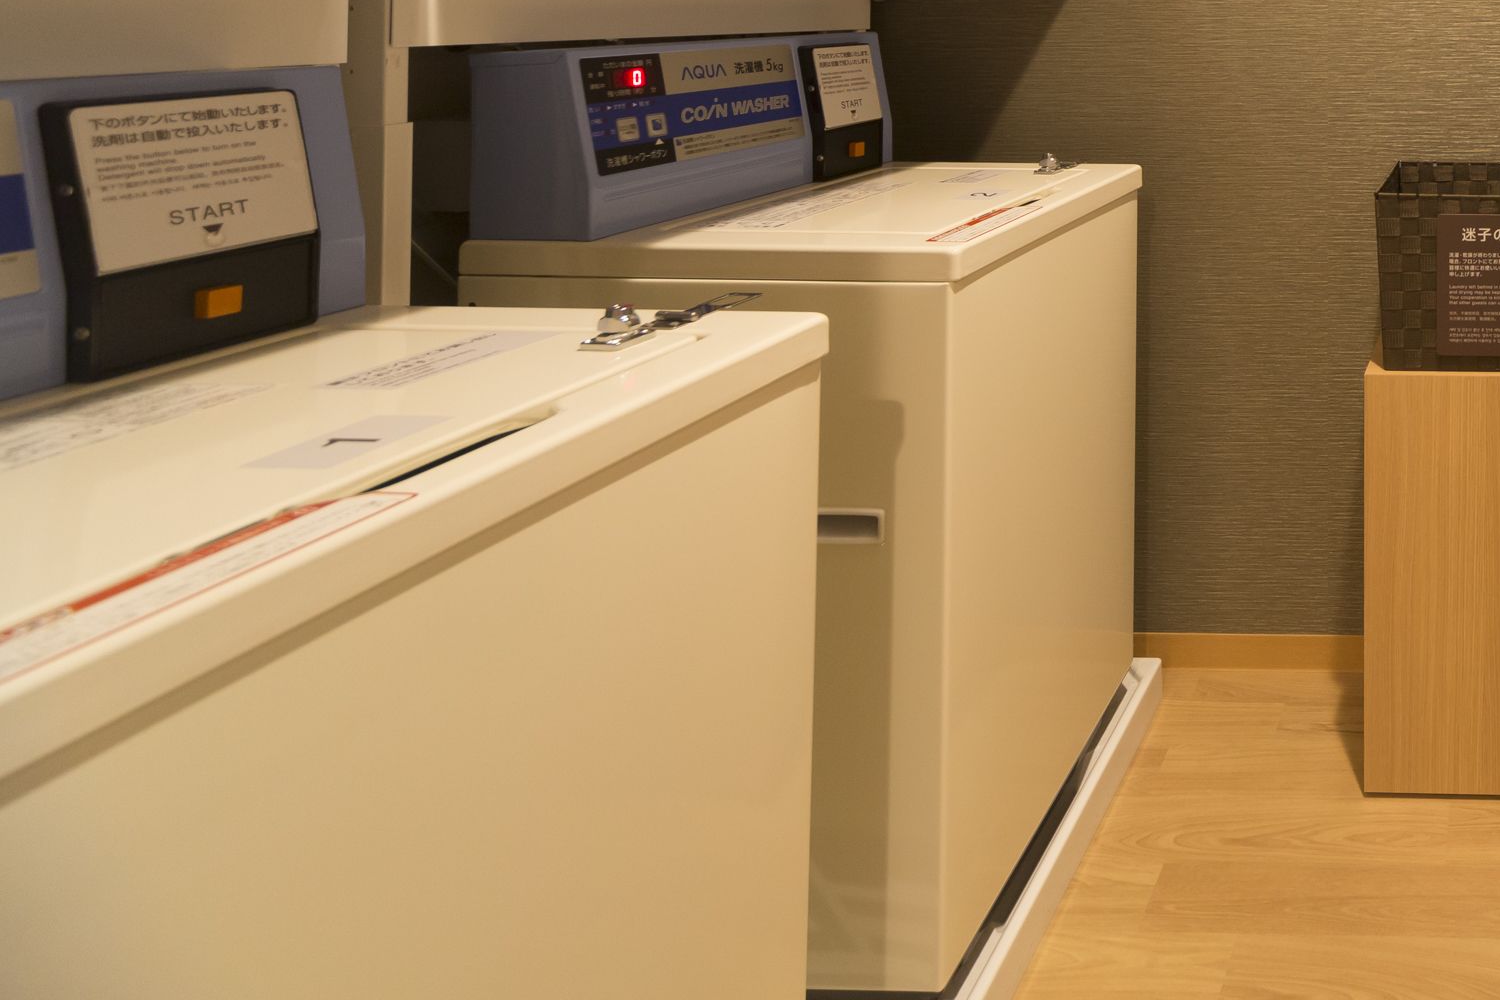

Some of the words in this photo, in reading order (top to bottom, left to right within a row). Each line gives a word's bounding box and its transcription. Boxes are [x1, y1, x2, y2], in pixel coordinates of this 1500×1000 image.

[734, 60, 764, 75] 洗濯機
[766, 58, 784, 73] 5kg
[632, 70, 642, 86] 0
[731, 94, 790, 116] WASHER
[840, 98, 863, 109] START
[88, 103, 287, 131] 下のボタンにて始動いたします。
[91, 118, 289, 148] 洗剤は自動で投入いたします。
[168, 198, 250, 226] START
